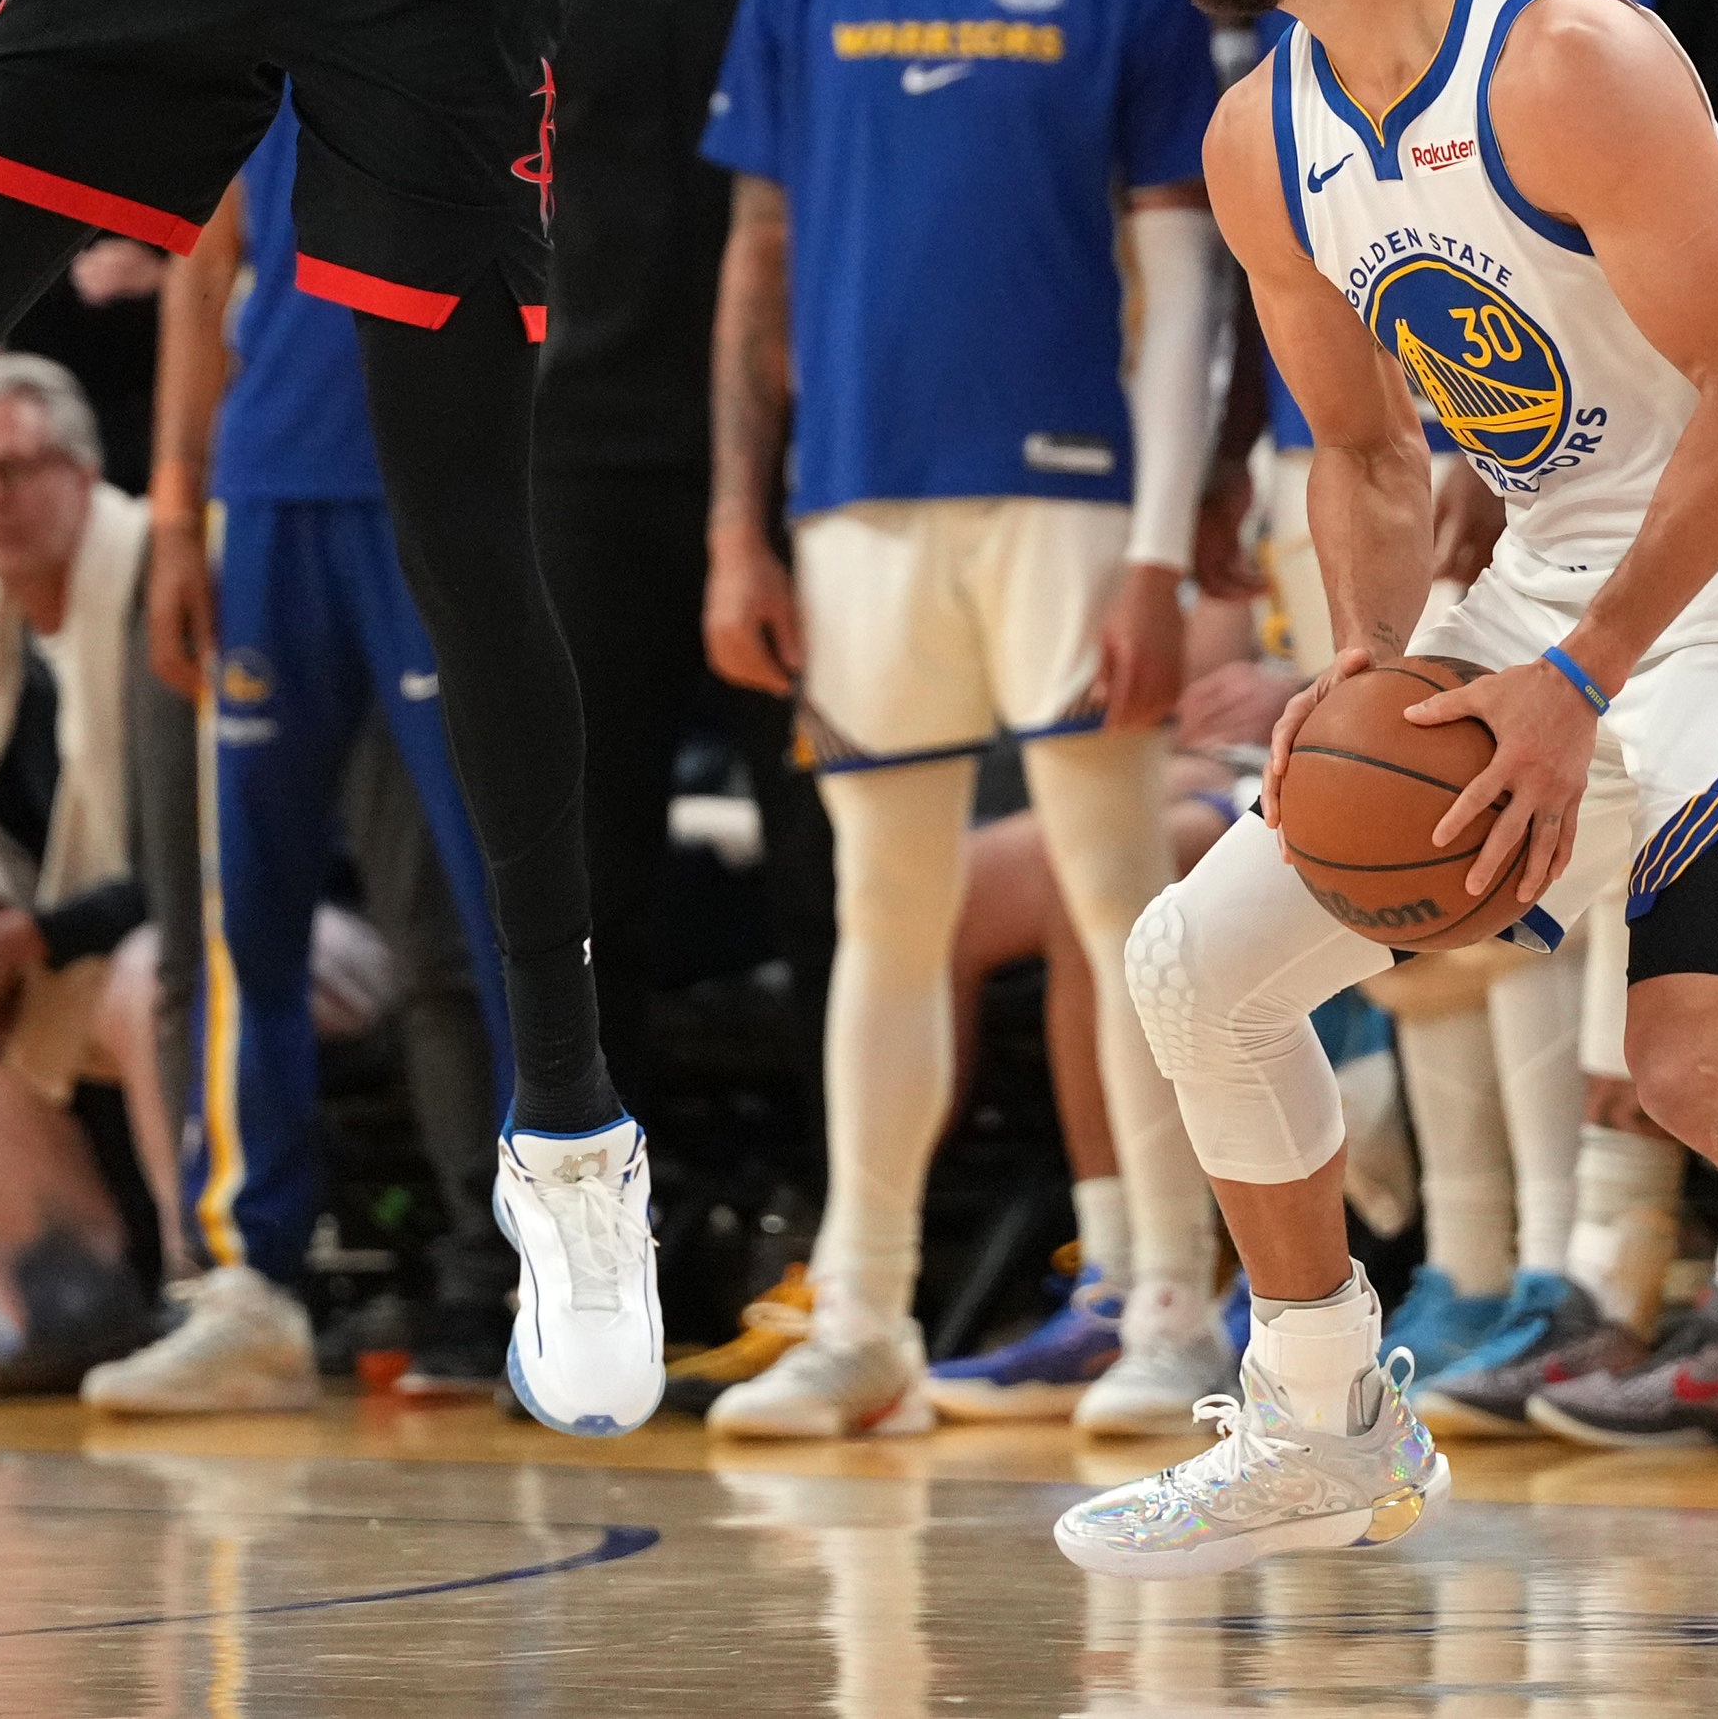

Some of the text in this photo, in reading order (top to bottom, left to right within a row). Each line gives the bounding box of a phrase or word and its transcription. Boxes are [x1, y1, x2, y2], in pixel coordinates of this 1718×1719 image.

[1411, 140, 1477, 168] Rakuten
[1344, 227, 1514, 309] GOLDEN STATE
[1448, 304, 1523, 368] 30
